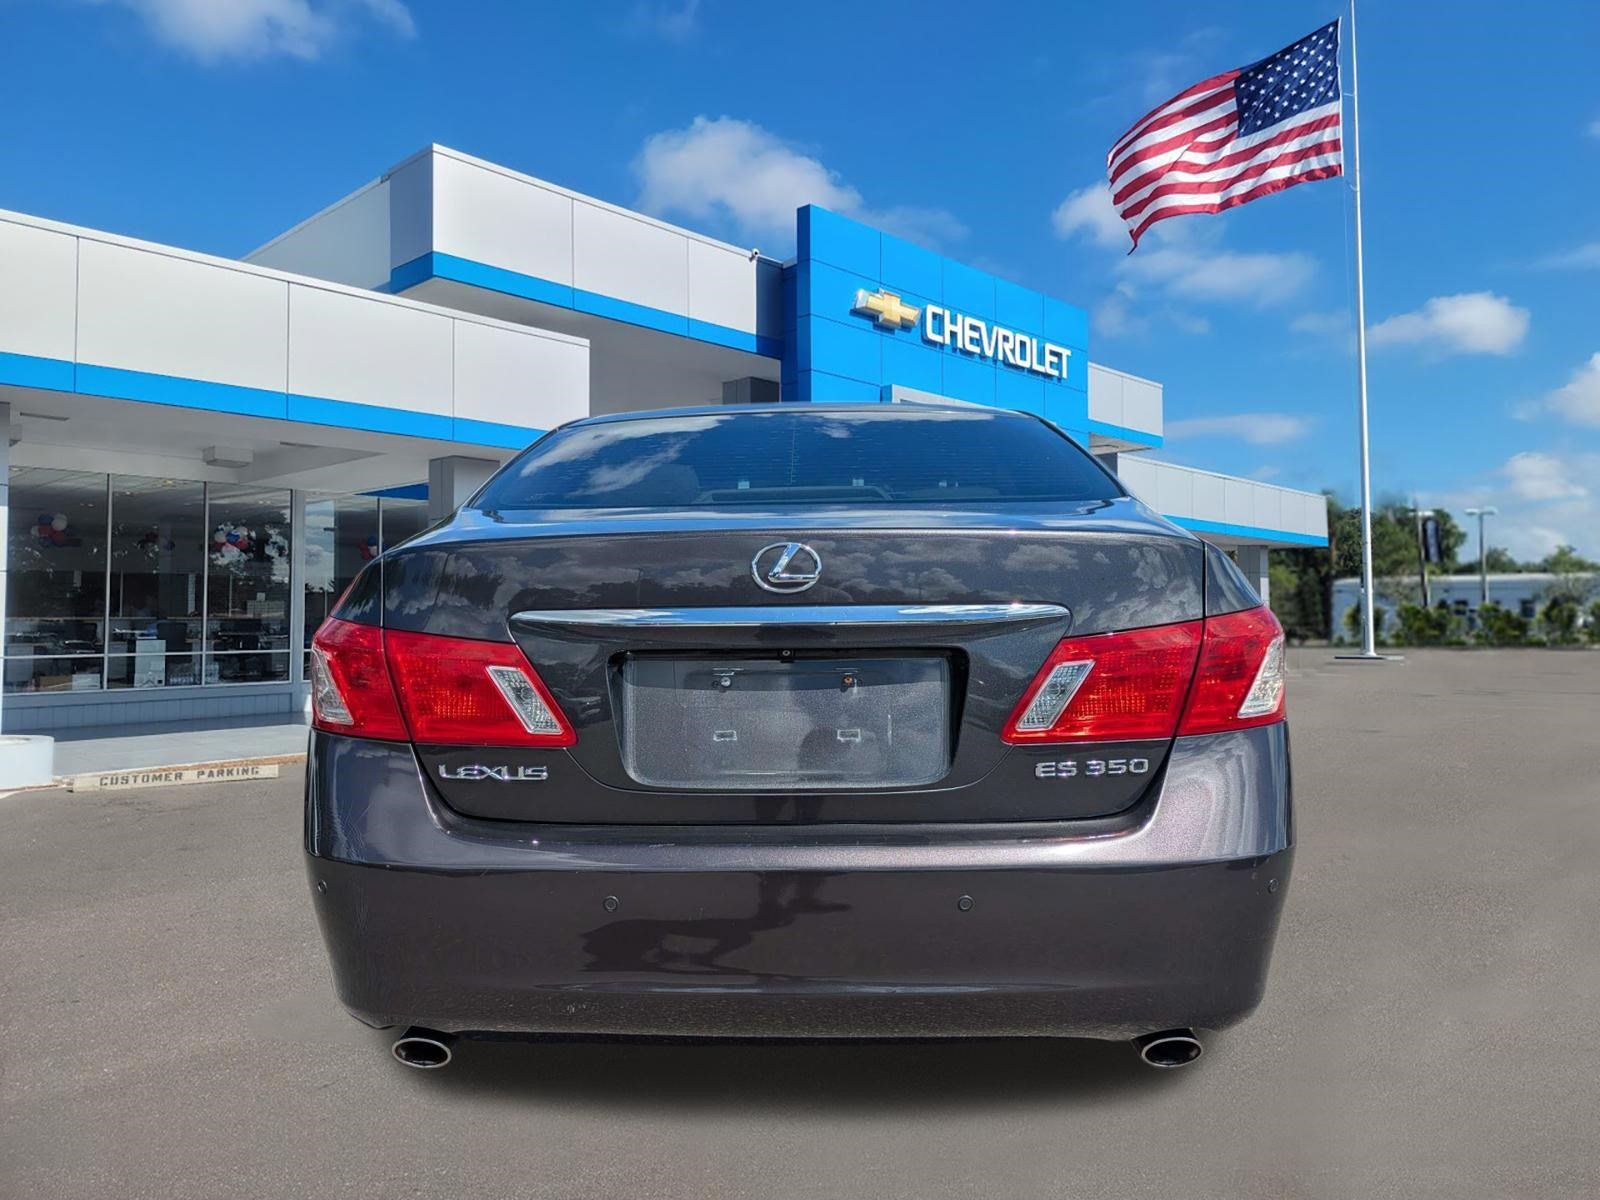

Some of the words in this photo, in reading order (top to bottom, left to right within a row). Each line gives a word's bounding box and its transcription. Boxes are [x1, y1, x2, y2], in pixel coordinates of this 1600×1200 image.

[924, 303, 1072, 379] CHEVROLET
[99, 772, 183, 787] CUSTOMER
[197, 766, 260, 779] PARKING
[438, 764, 548, 781] LEXUS
[1035, 761, 1077, 777] ES
[1085, 759, 1149, 775] 350
